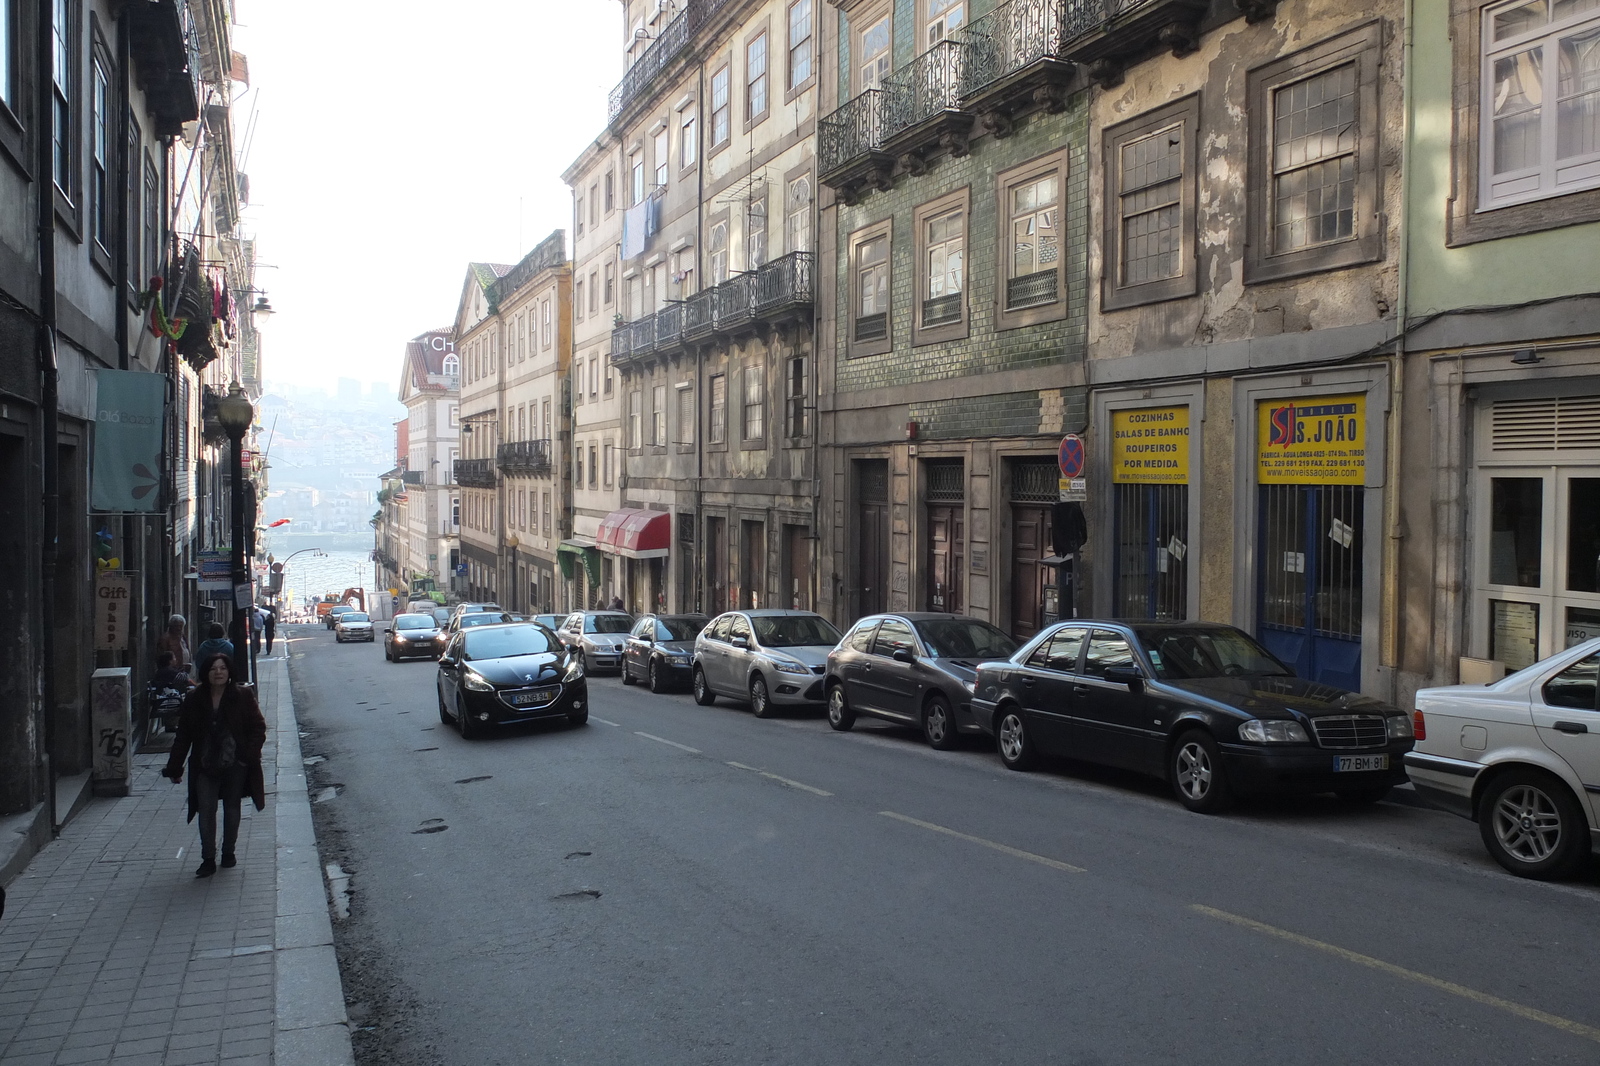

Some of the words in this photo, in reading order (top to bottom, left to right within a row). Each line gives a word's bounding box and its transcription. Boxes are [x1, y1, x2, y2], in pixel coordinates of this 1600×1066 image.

[1128, 412, 1174, 423] COZINHAS
[1115, 429, 1142, 439] SALAS
[1144, 428, 1156, 437] DE
[1158, 427, 1189, 437] BANHO
[1126, 443, 1177, 453] ROUPEIROS
[1124, 460, 1142, 468] POR
[1144, 460, 1178, 468] MEDIDA
[1266, 469, 1357, 479] www.moveissaojoao.com
[98, 586, 128, 599] Gift
[107, 602, 117, 643] Shop
